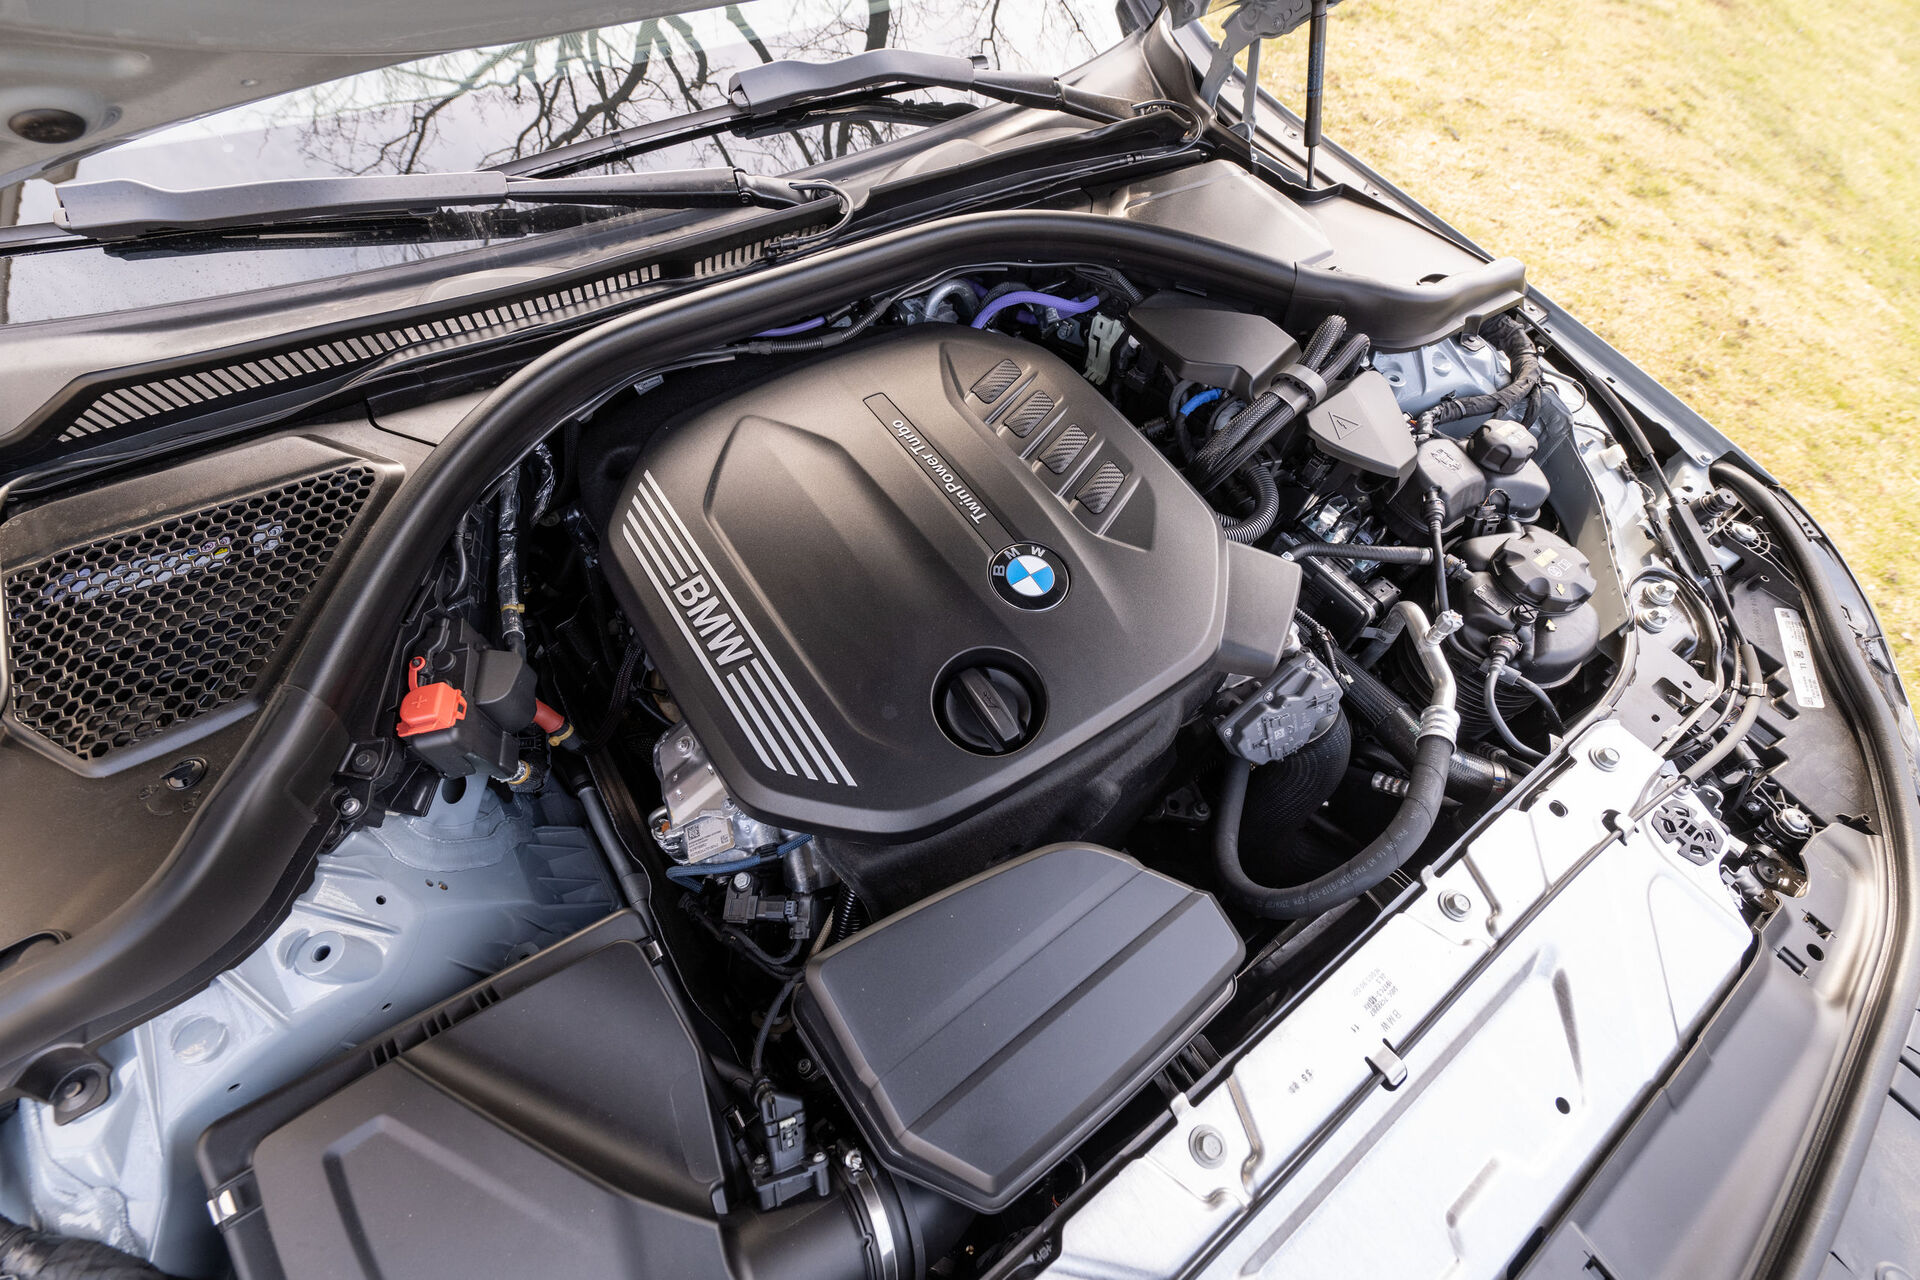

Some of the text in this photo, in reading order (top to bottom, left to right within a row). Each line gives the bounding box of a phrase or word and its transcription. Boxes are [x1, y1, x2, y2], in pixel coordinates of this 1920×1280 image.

[893, 419, 987, 524] TwinPower Turbo
[993, 546, 1046, 577] BMW
[672, 574, 753, 666] BMW
[1380, 1009, 1401, 1032] BMW
